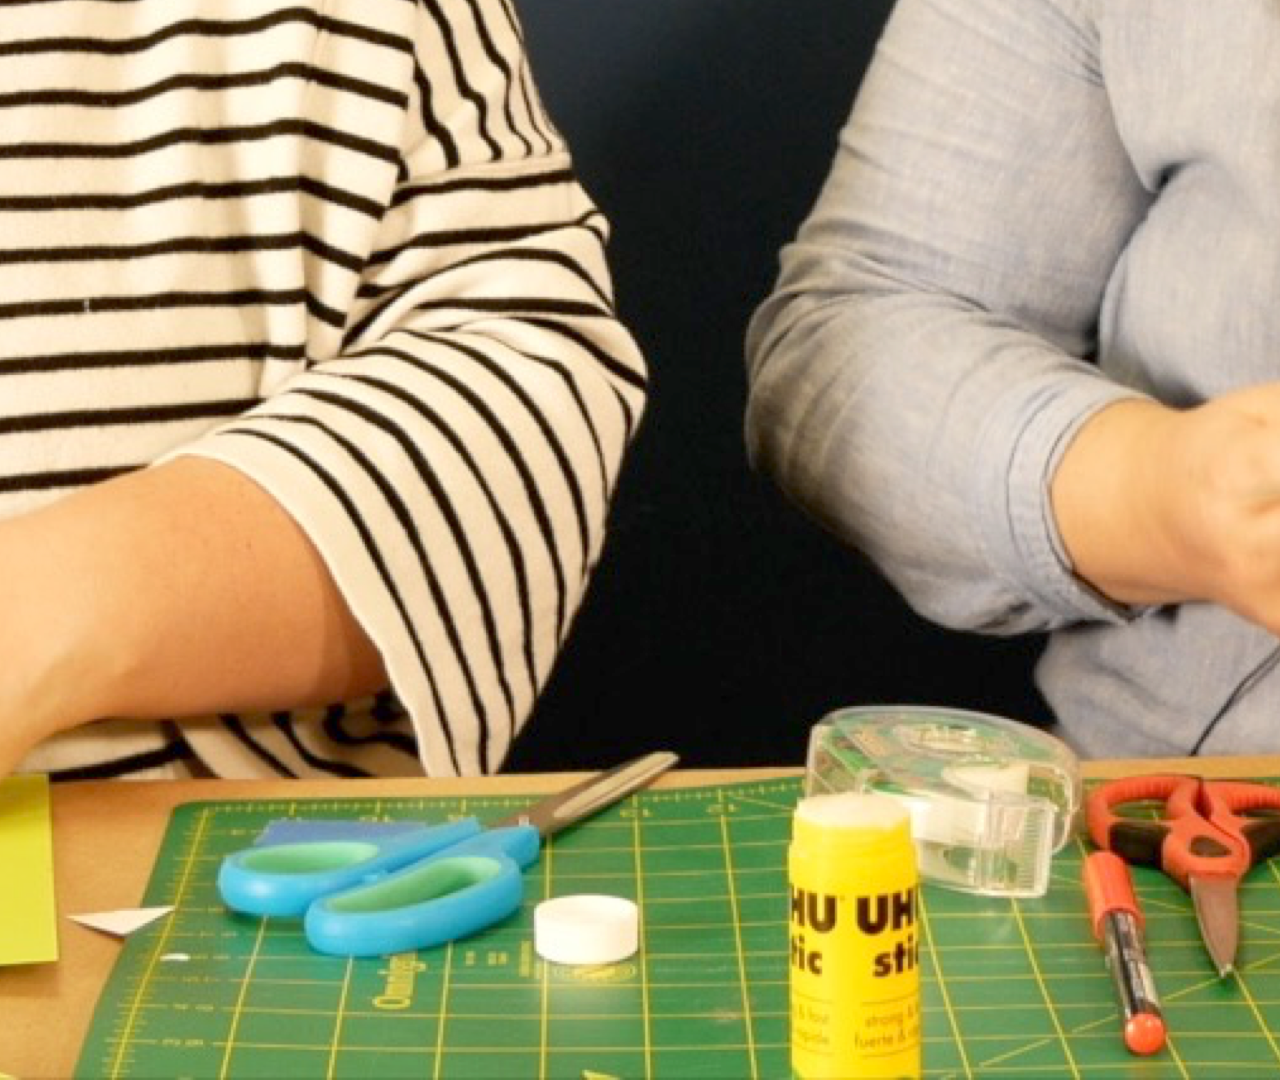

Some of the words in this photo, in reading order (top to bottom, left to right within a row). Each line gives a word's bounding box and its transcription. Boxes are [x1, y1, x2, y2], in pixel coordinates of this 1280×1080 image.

[791, 888, 837, 932] HU
[857, 888, 919, 935] UH
[792, 935, 823, 976] tic
